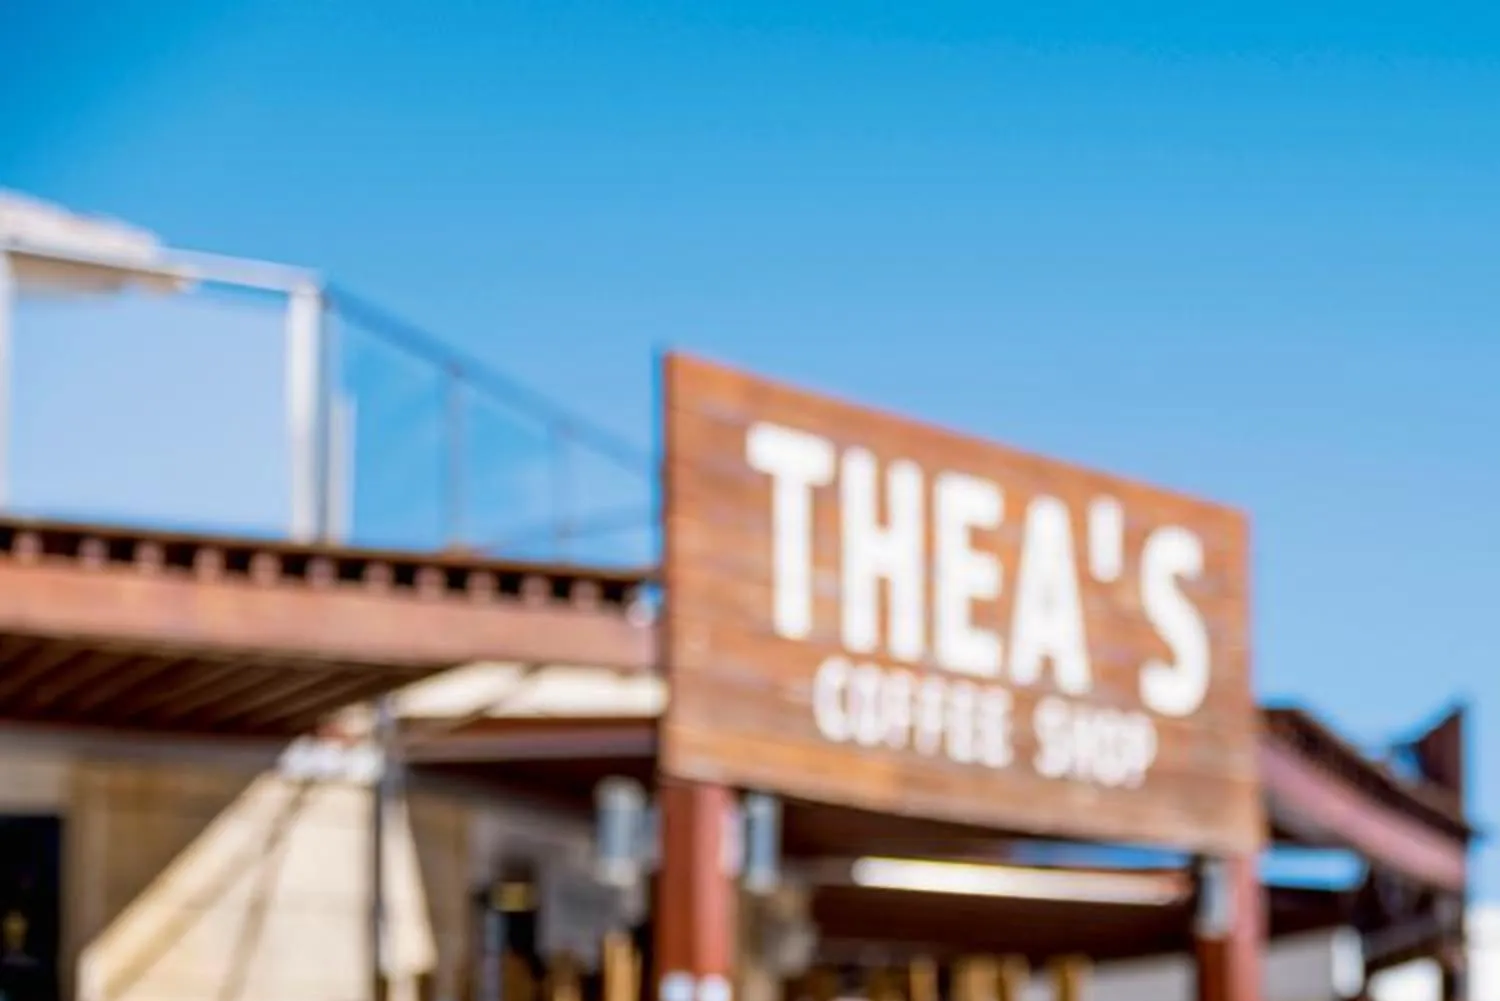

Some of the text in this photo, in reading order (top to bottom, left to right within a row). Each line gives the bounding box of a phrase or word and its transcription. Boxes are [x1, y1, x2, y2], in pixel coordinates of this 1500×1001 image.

[747, 422, 1209, 715] THEA'S
[814, 656, 1156, 787] COFFEE SHOP
